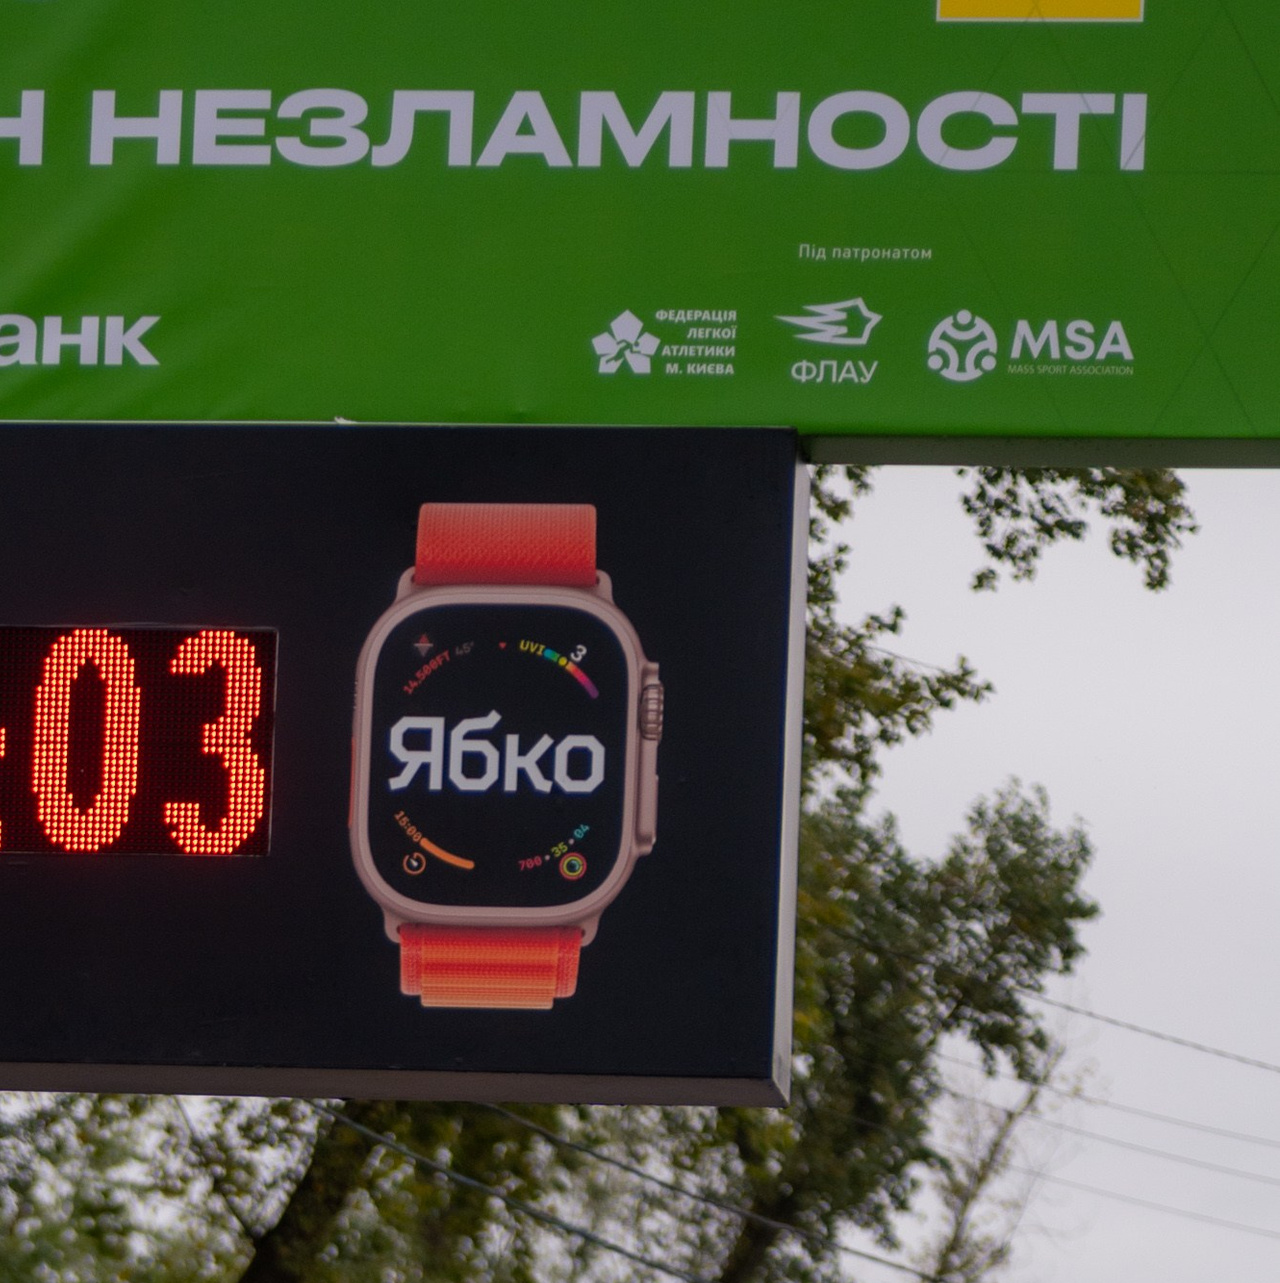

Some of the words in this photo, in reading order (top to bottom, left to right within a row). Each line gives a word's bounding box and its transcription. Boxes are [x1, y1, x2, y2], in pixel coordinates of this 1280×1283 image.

[89, 88, 1148, 171] НЕЗЛАМНОСТІ
[798, 243, 827, 260] Під
[832, 247, 933, 262] патронатом
[655, 309, 737, 324] ФЕДЕРАЦІЯ
[687, 325, 737, 339] ЛЕГКОЇ
[1010, 319, 1135, 360] MSA
[661, 344, 735, 357] АТЛЕТИКИ
[665, 362, 683, 375] М.
[686, 362, 734, 376] КИЄВА
[790, 359, 878, 383] ФЛАУ
[1007, 364, 1035, 375] MASS
[1038, 364, 1067, 375] SPORT
[1069, 365, 1135, 376] ASSOCIATION
[388, 709, 606, 794] Ябко
